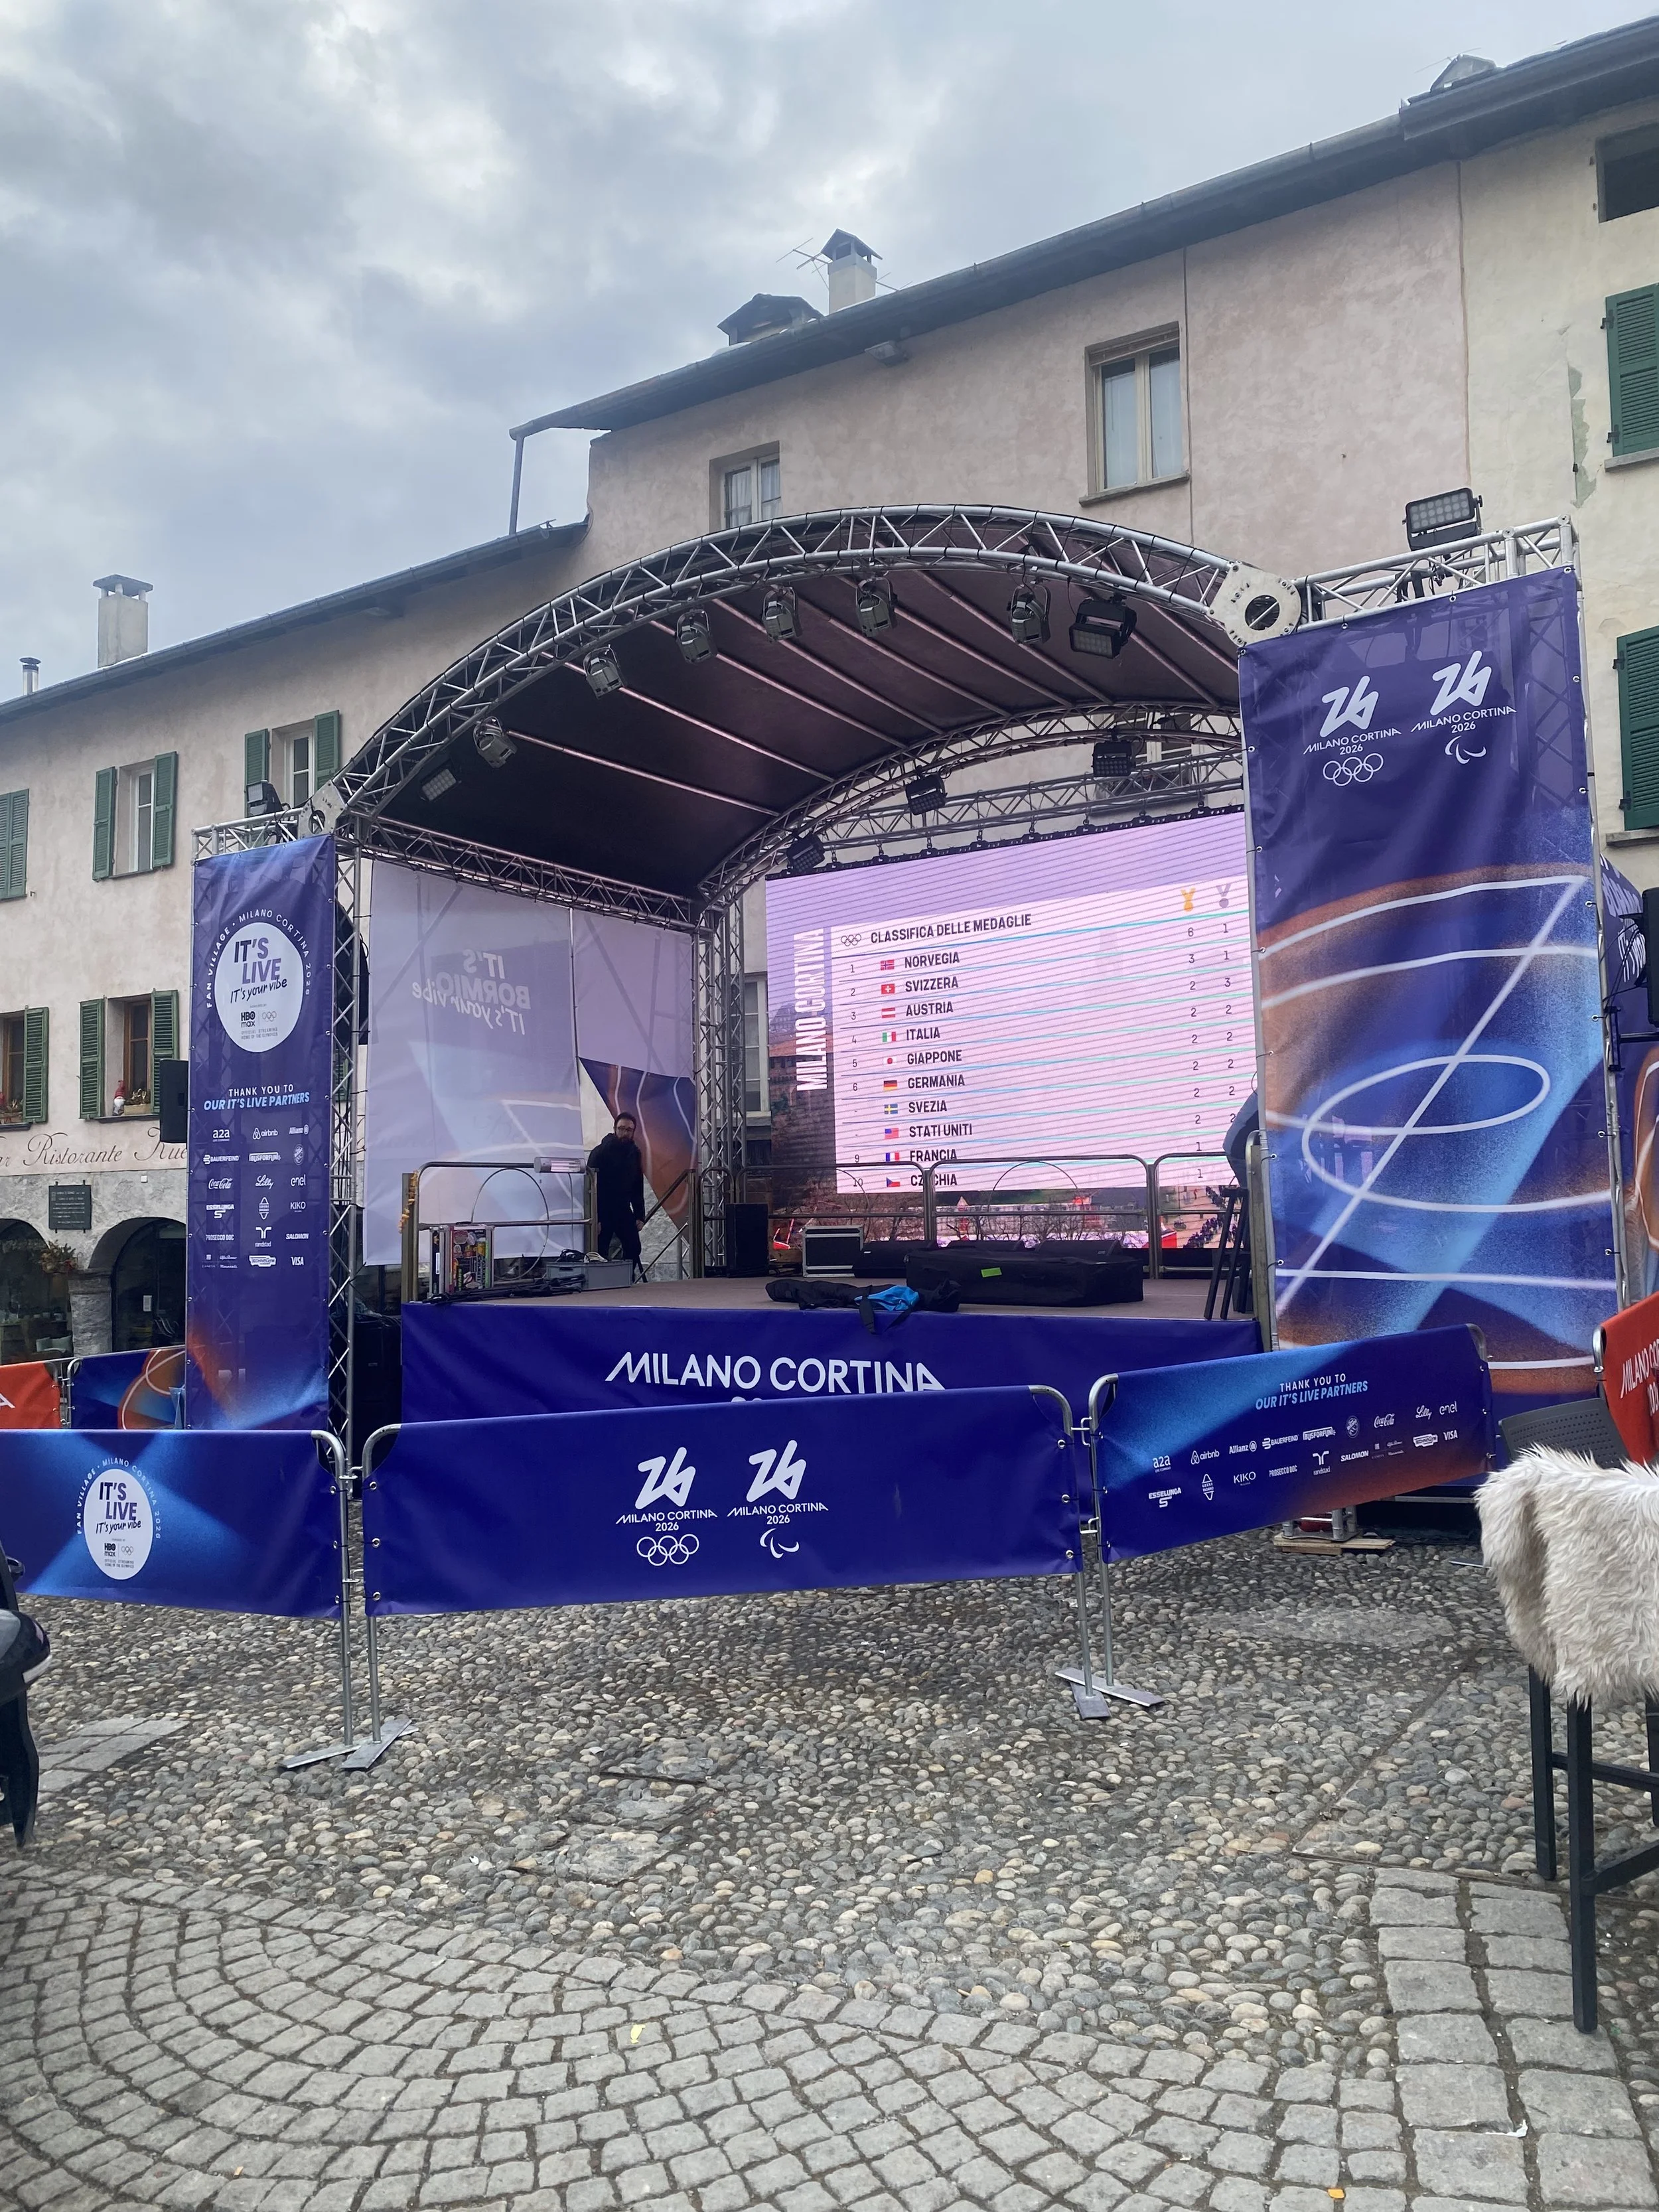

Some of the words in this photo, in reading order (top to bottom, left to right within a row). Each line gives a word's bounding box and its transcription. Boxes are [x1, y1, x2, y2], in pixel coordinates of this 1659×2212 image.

[1411, 713, 1461, 732] MILANO
[1463, 705, 1516, 721] CORTINA
[1451, 722, 1476, 733] 2026
[1303, 736, 1349, 755] MILANO
[1351, 727, 1402, 745] CORTINA
[1340, 744, 1363, 755] 2026
[871, 926, 934, 944] CLASSIFICA
[936, 921, 971, 936] DELLE
[973, 913, 1032, 932] MEDAGLIE
[1188, 927, 1194, 937] 6
[1223, 923, 1229, 933] 1
[208, 926, 231, 976] VILLAGE
[239, 909, 273, 922] MILANO
[275, 914, 309, 957] CORTINA
[234, 937, 269, 963] IT'S
[904, 951, 960, 968] NORVEGIA
[1189, 954, 1194, 964] 3
[1224, 950, 1229, 960] 1
[242, 958, 281, 984] LIVE
[794, 928, 826, 1013] CORTINA
[246, 984, 268, 1003] your
[269, 976, 287, 992] vibe
[905, 976, 958, 992] SVIZZERA
[1190, 981, 1196, 990] 2
[1224, 978, 1230, 988] 3
[906, 1001, 954, 1017] AUSTRIA
[1190, 1007, 1196, 1017] 2
[1225, 1005, 1232, 1015] 2
[241, 1011, 255, 1021] HBO
[906, 1027, 940, 1041] ITALIA
[1191, 1034, 1198, 1044] 2
[1226, 1032, 1233, 1041] 2
[795, 1017, 828, 1091] MILANO
[907, 1050, 962, 1065] GIAPPONE
[1192, 1061, 1198, 1070] 2
[1227, 1059, 1234, 1069] 2
[908, 1074, 965, 1089] GERMANIA
[228, 1087, 257, 1097] THANK
[261, 1085, 279, 1094] YOU
[283, 1084, 293, 1092] TO
[1193, 1088, 1200, 1098] 2
[1228, 1086, 1235, 1096] 2
[204, 1100, 225, 1110] OUR
[227, 1098, 245, 1109] IT'S
[246, 1096, 267, 1108] LIVE
[269, 1092, 310, 1106] PARTNERS
[908, 1100, 947, 1113] SVEZIA
[1194, 1115, 1200, 1124] 2
[1230, 1114, 1236, 1123] 2
[213, 1129, 230, 1138] a2a
[909, 1125, 942, 1138] STATI
[944, 1123, 972, 1136] UNITI
[23, 1132, 122, 1166] Ristorante
[1196, 1142, 1201, 1151] 1
[910, 1149, 958, 1161] FRANCIA
[291, 1174, 306, 1187] enel
[910, 1174, 958, 1186] CZCHIA
[1197, 1169, 1203, 1179] 1
[291, 1257, 304, 1266] VISA
[605, 1351, 760, 1389] MILANO
[769, 1357, 946, 1394] CORTINA
[1280, 1379, 1310, 1392] THANK
[1314, 1376, 1331, 1386] YOU
[1335, 1373, 1346, 1383] TO
[1256, 1396, 1277, 1410] OUR
[1279, 1393, 1297, 1406] IT'S
[1299, 1388, 1319, 1403] LIVE
[1321, 1380, 1368, 1399] PARTNERS
[1415, 1405, 1432, 1420] Lilly
[1439, 1401, 1457, 1415] enel
[1271, 1435, 1298, 1445] BAUERFEIND
[1443, 1430, 1458, 1441] VISA
[1200, 1449, 1220, 1460] airbnb
[1229, 1444, 1248, 1454] Allianz
[1153, 1455, 1171, 1468] a2a
[1340, 1450, 1369, 1462] SALOMON
[1234, 1471, 1256, 1483] KIKO
[1269, 1467, 1289, 1477] PROSECCO
[1313, 1466, 1331, 1475] randstad
[77, 1468, 96, 1507] VILLAGE
[102, 1457, 129, 1467] MILANO
[132, 1465, 157, 1506] CORTINA
[99, 1482, 126, 1501] IT'S
[1149, 1487, 1181, 1499] ESSELUNGA
[106, 1502, 137, 1520] LIVE
[727, 1505, 776, 1517] MILANO
[778, 1502, 829, 1513] CORTINA
[616, 1512, 665, 1524] MILANO
[667, 1509, 717, 1520] CORTINA
[766, 1515, 790, 1524] 2026
[109, 1521, 126, 1534] your
[127, 1518, 141, 1528] vibe
[655, 1522, 679, 1532] 2026
[104, 1542, 116, 1551] HBO
